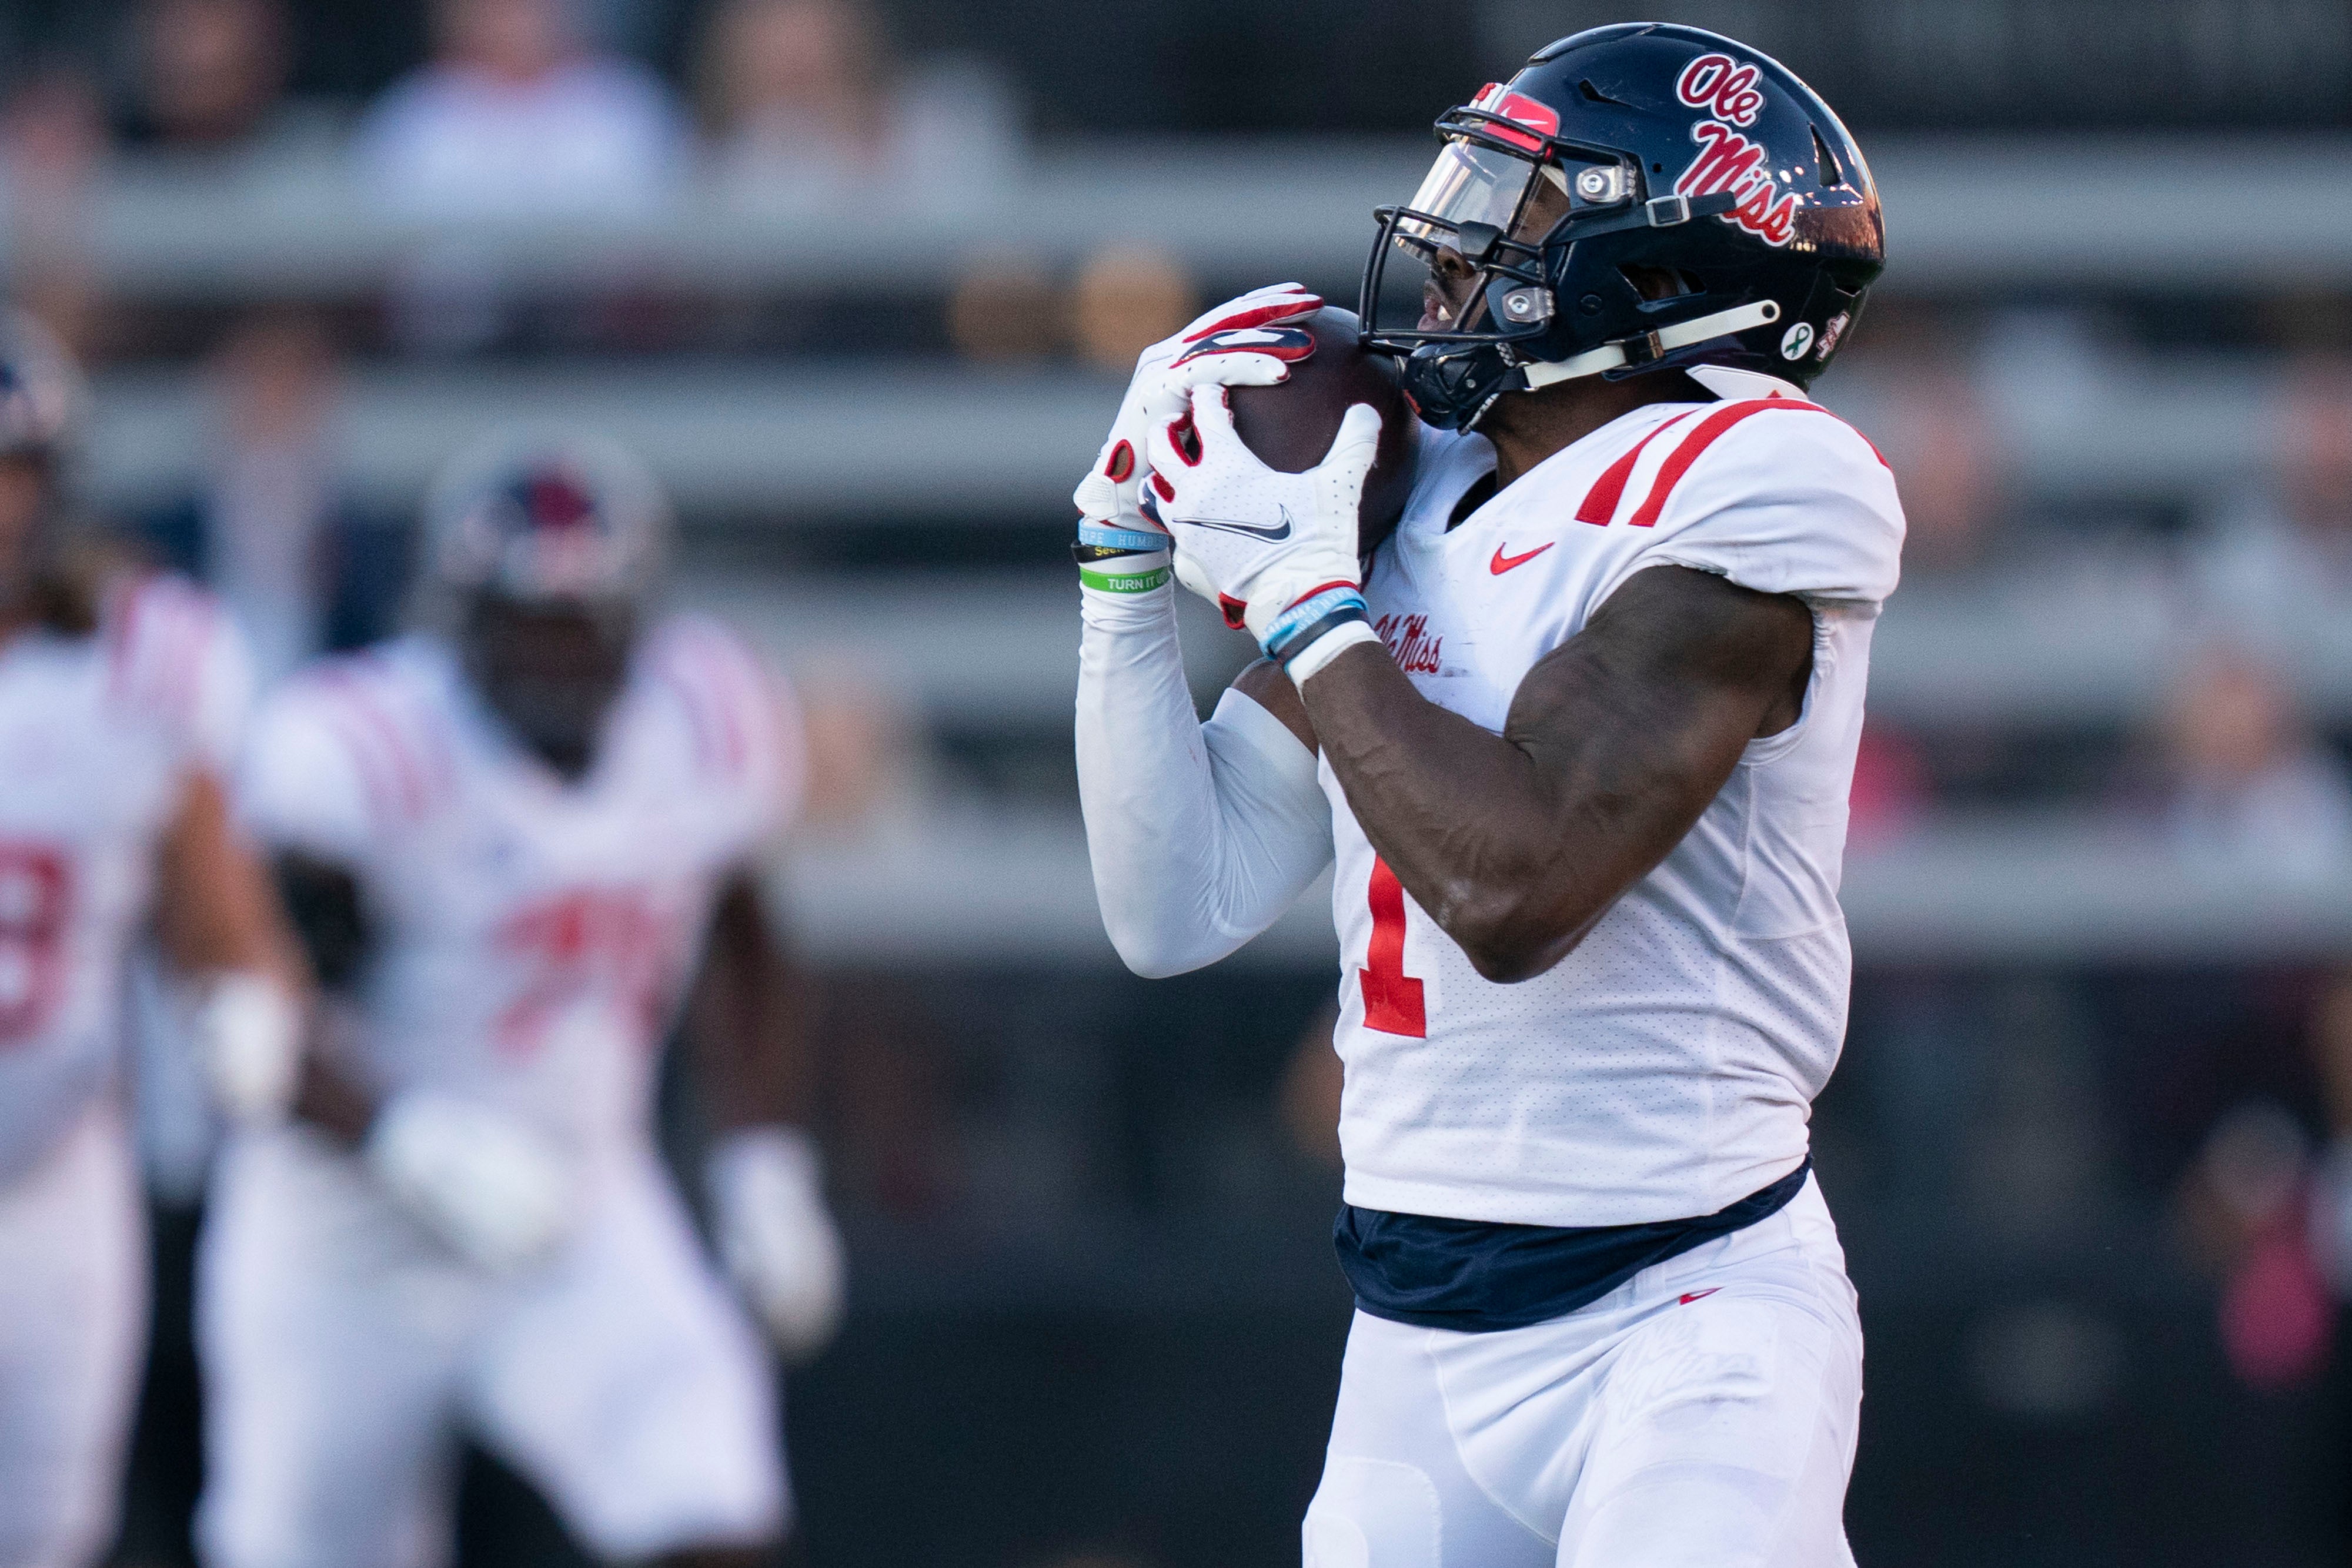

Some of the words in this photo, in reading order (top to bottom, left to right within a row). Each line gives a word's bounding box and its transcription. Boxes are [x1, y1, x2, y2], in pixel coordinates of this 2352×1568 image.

[1678, 54, 1762, 126] Ole
[1674, 121, 1795, 245] Miss
[1108, 579, 1144, 590] TURN
[1145, 576, 1155, 587] IT
[1395, 612, 1444, 674] Miss
[1359, 851, 1426, 1038] 1
